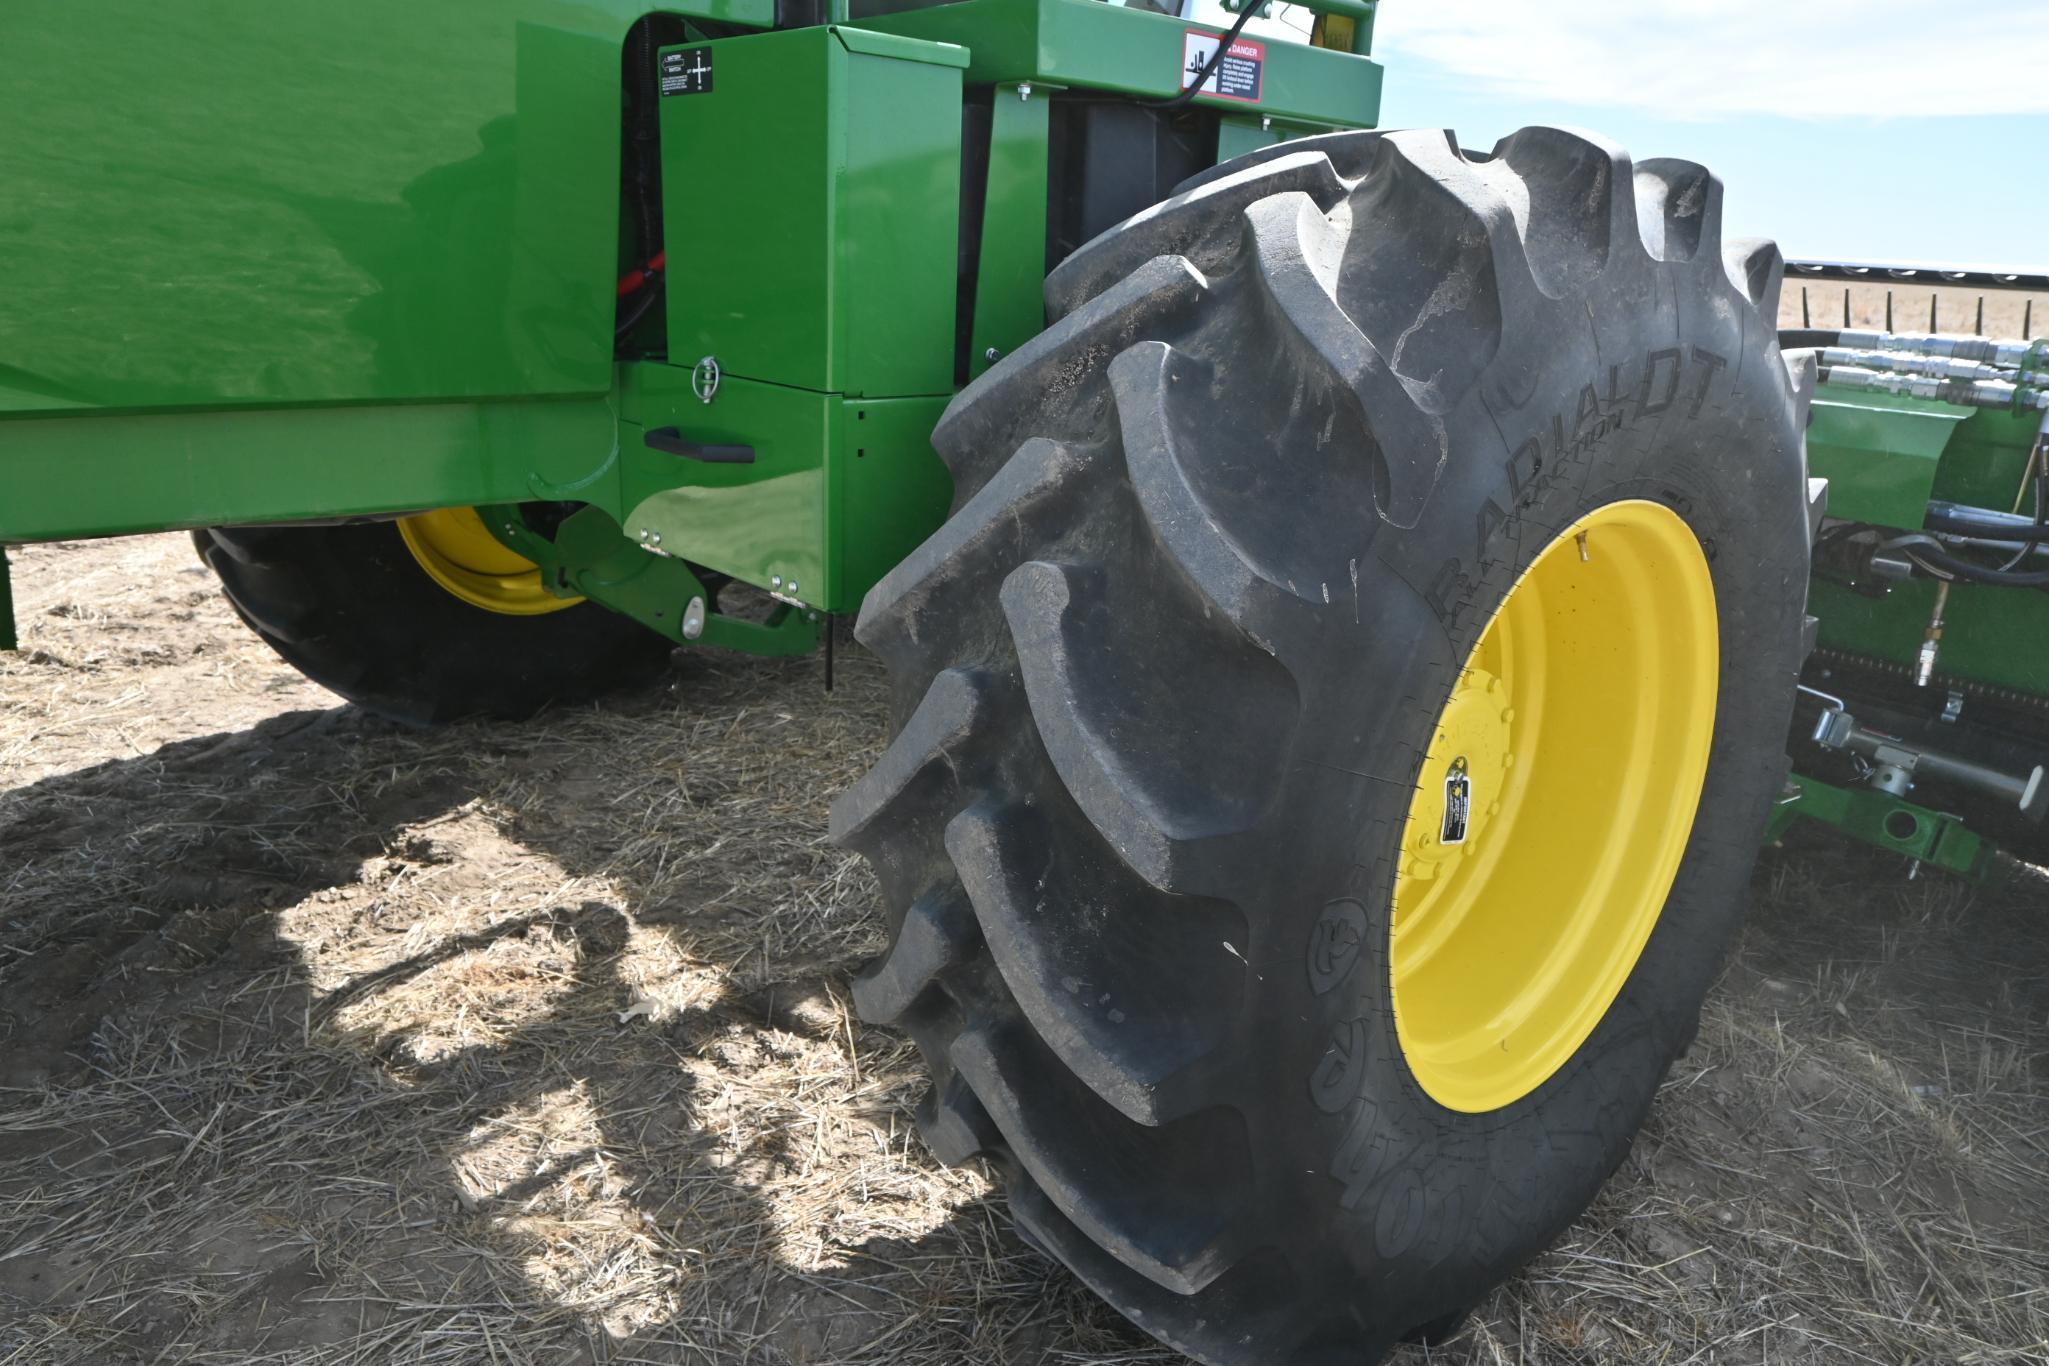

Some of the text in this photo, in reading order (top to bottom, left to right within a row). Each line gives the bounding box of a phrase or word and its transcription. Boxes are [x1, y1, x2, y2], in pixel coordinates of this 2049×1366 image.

[1232, 45, 1257, 56] DANGER
[1425, 344, 1727, 620] RADIAL DT
